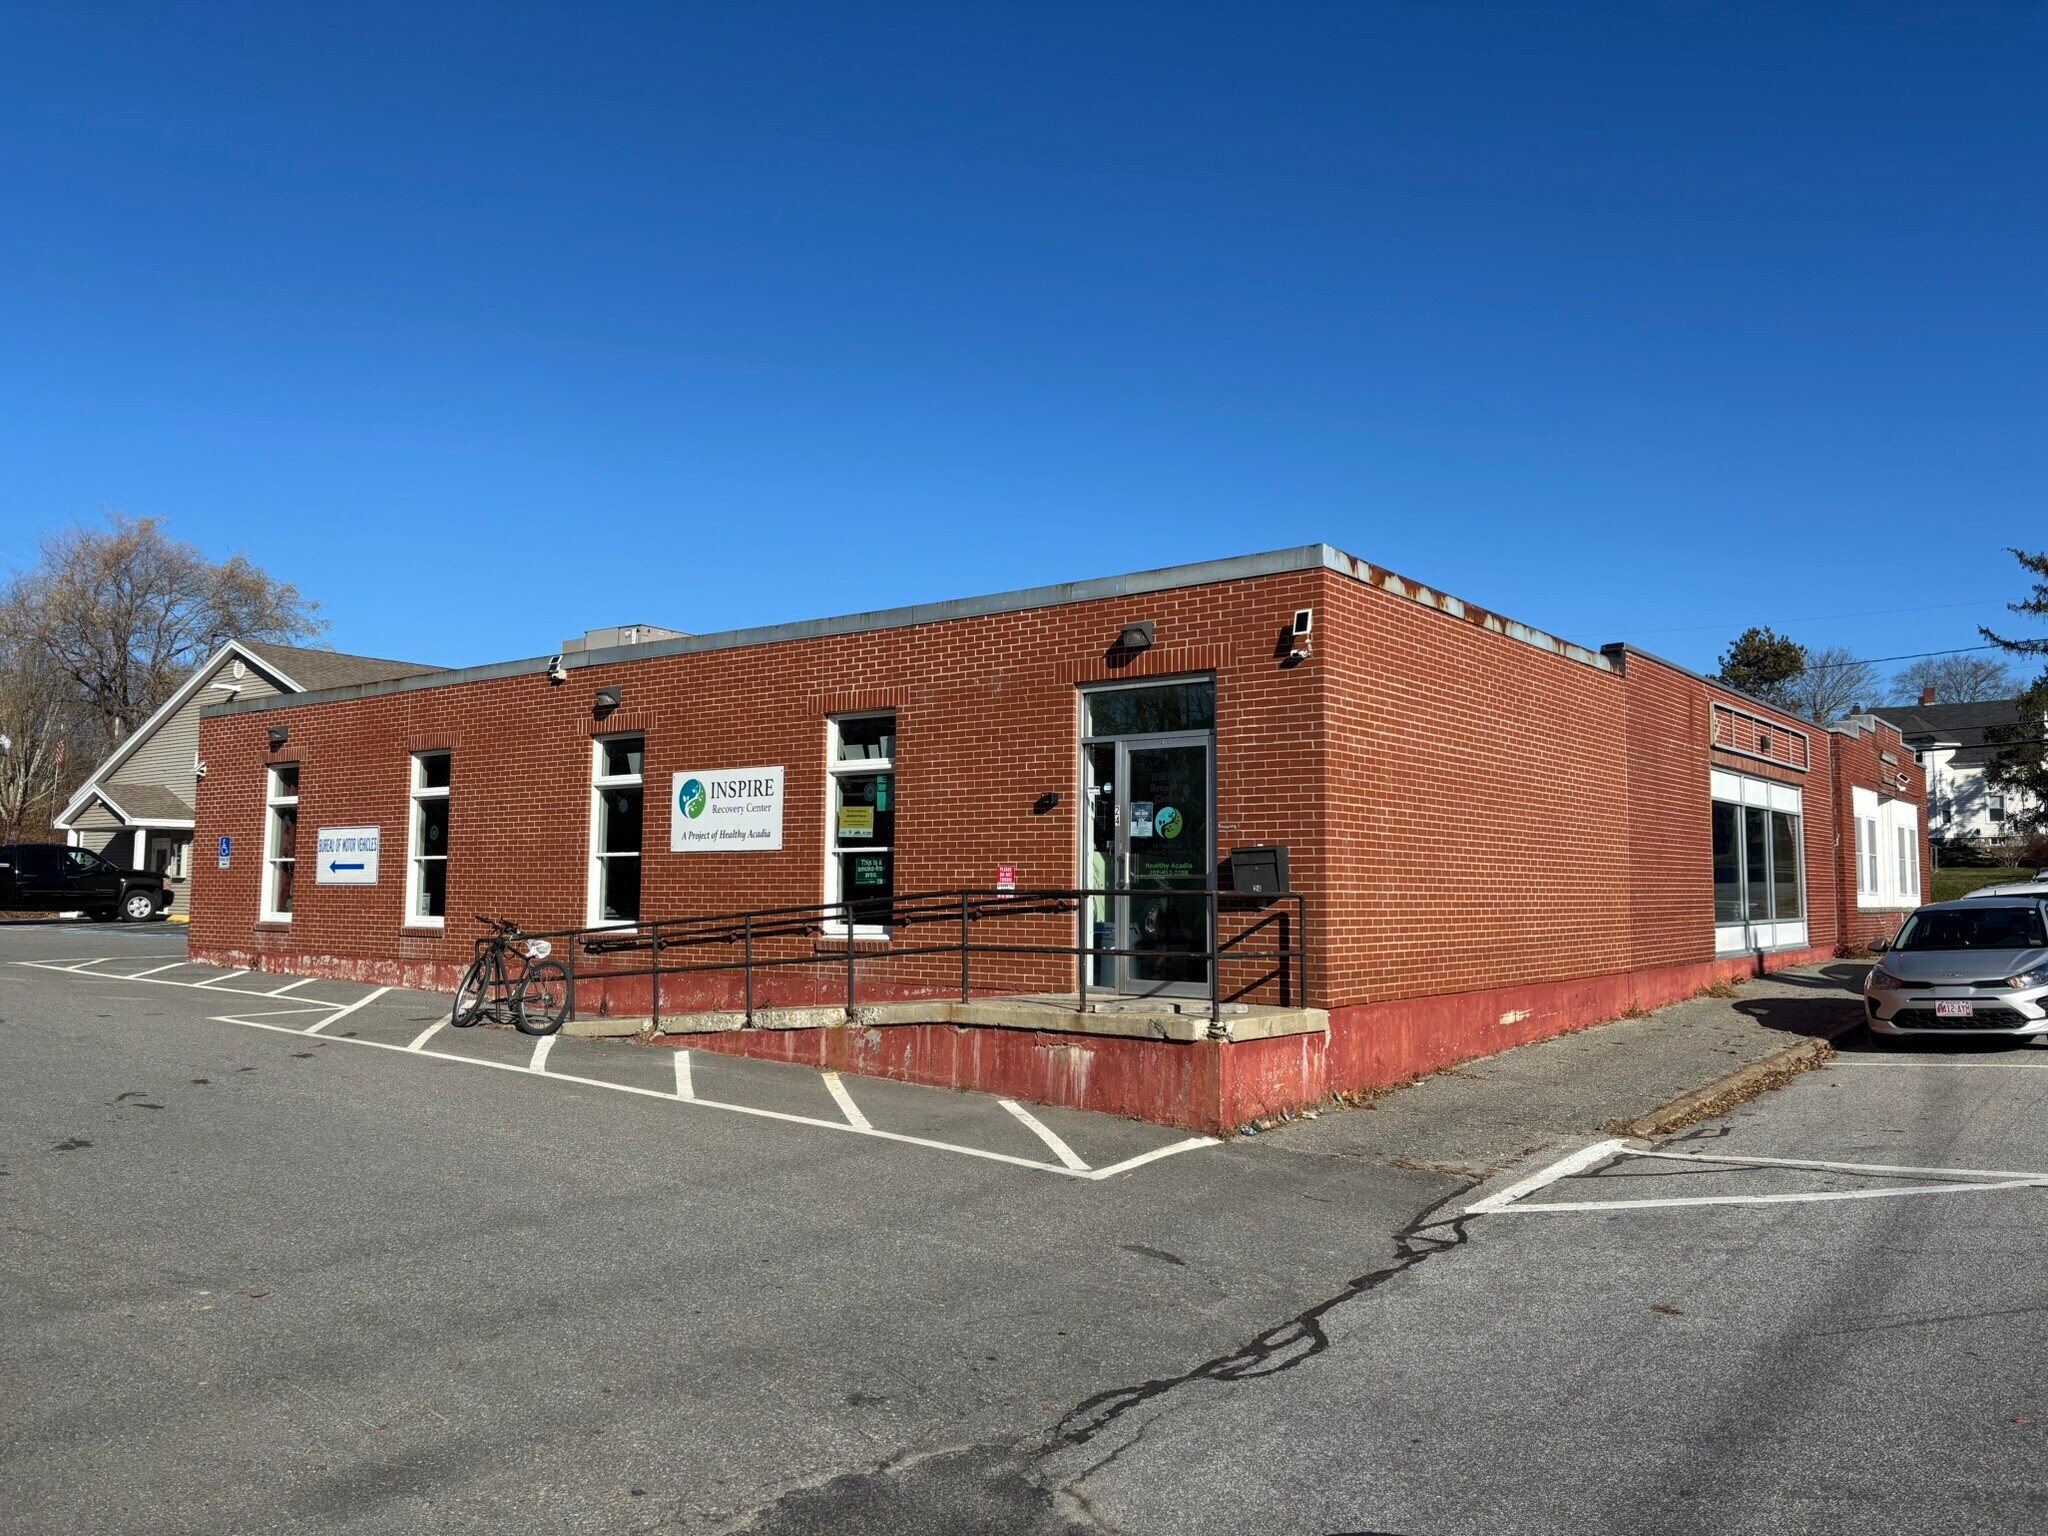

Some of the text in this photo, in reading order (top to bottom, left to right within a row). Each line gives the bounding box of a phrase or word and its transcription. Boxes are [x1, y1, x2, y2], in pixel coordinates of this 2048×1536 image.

[711, 779, 774, 799] INSPIRE
[712, 803, 772, 815] Recovery Center
[681, 829, 771, 842] A Project of Healthy Acadia
[319, 837, 377, 852] BUREAU OF MOTOR VEHICLES
[1145, 862, 1169, 870] Healthy
